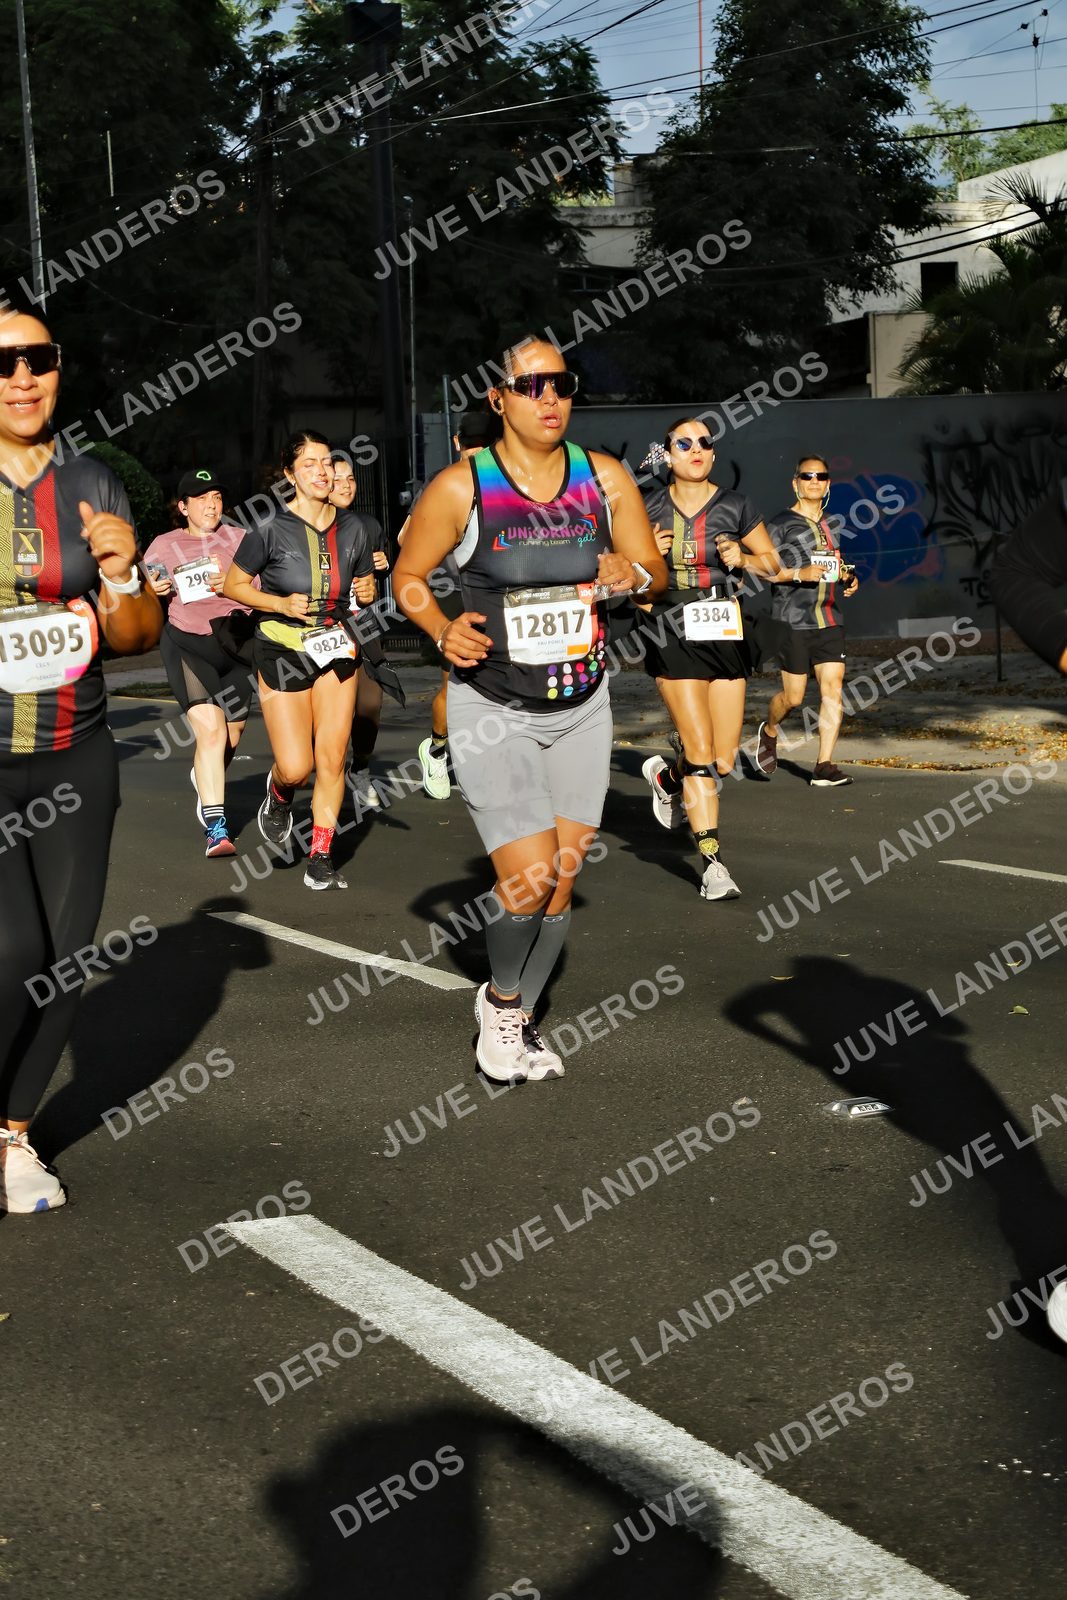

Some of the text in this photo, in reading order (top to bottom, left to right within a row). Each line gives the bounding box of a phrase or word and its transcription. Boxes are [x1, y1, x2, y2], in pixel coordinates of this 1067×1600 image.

[511, 608, 586, 639] 12817
[692, 607, 731, 623] 3384
[312, 634, 348, 654] 9824
